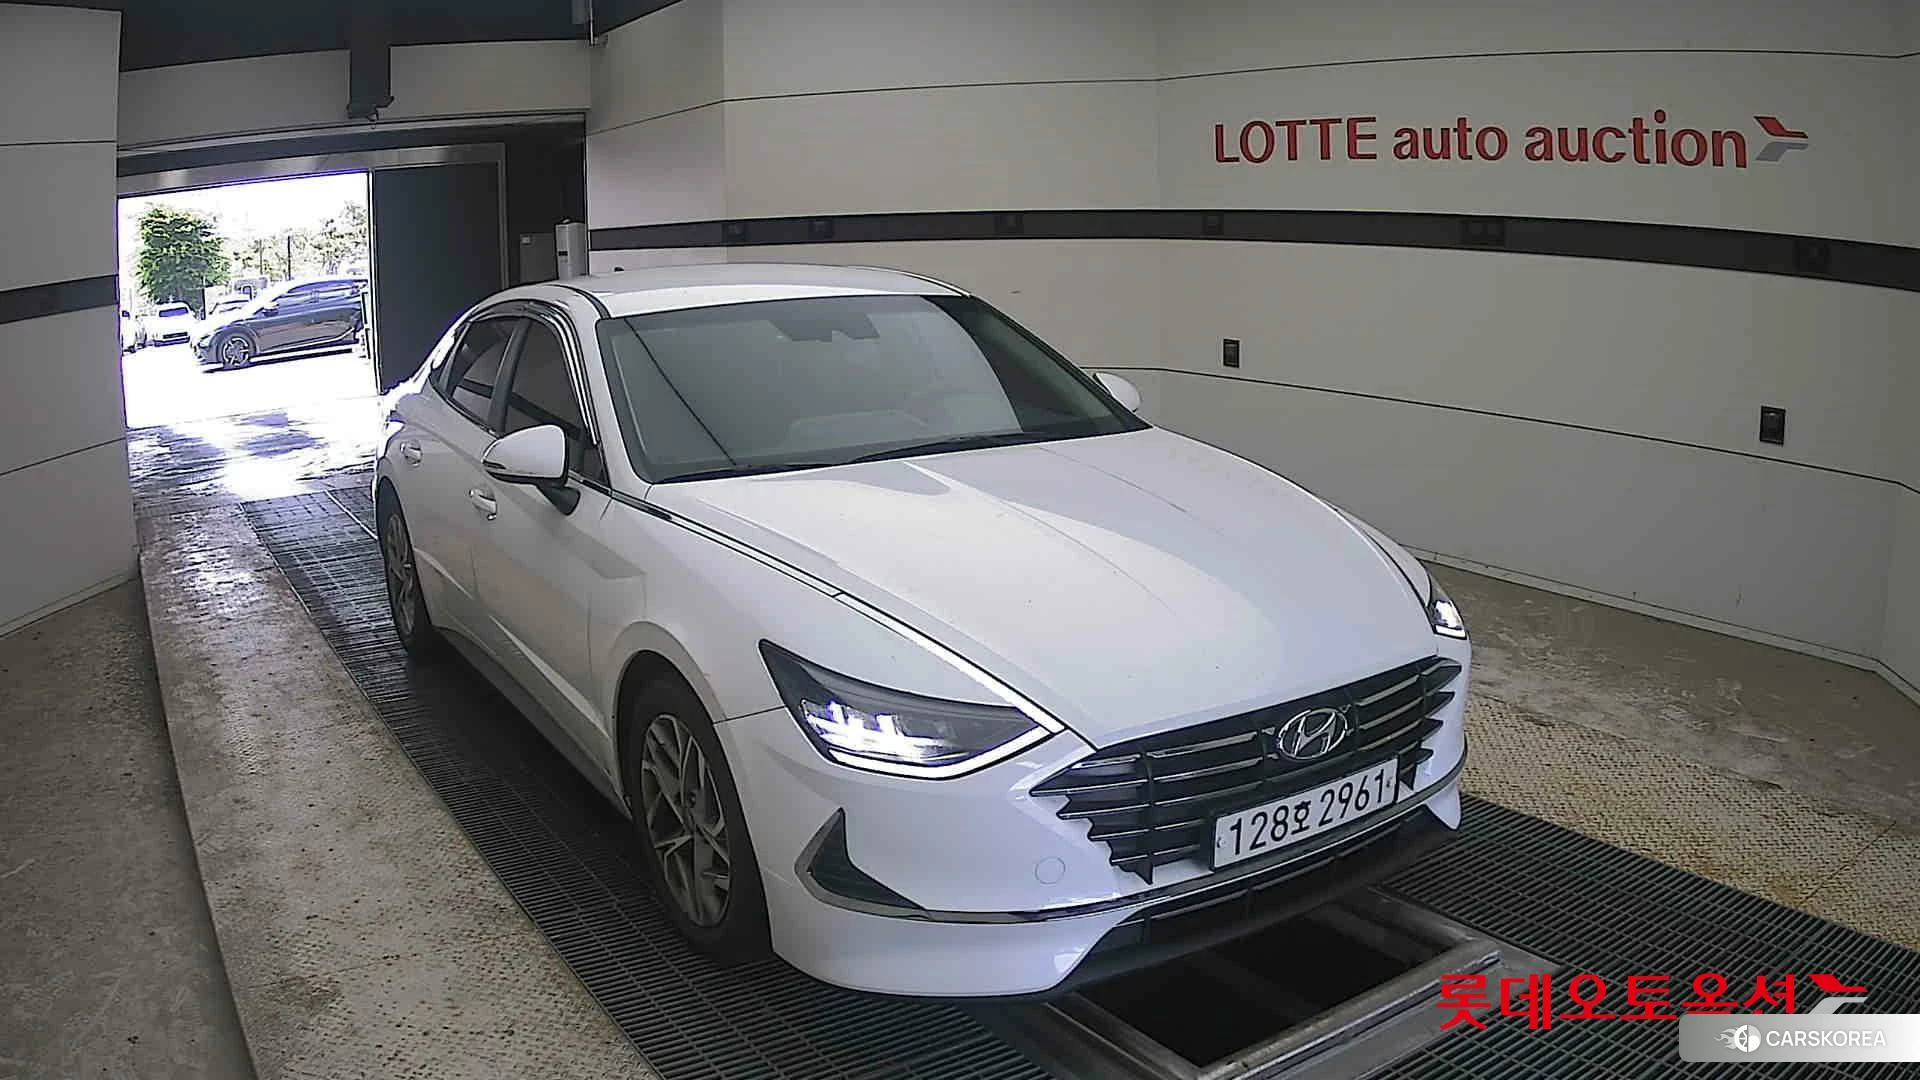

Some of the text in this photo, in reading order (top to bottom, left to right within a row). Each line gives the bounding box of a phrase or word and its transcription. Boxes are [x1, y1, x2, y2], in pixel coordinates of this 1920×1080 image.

[1214, 109, 1747, 168] LOTTE auto auction
[1229, 768, 1385, 855] 128호 2961
